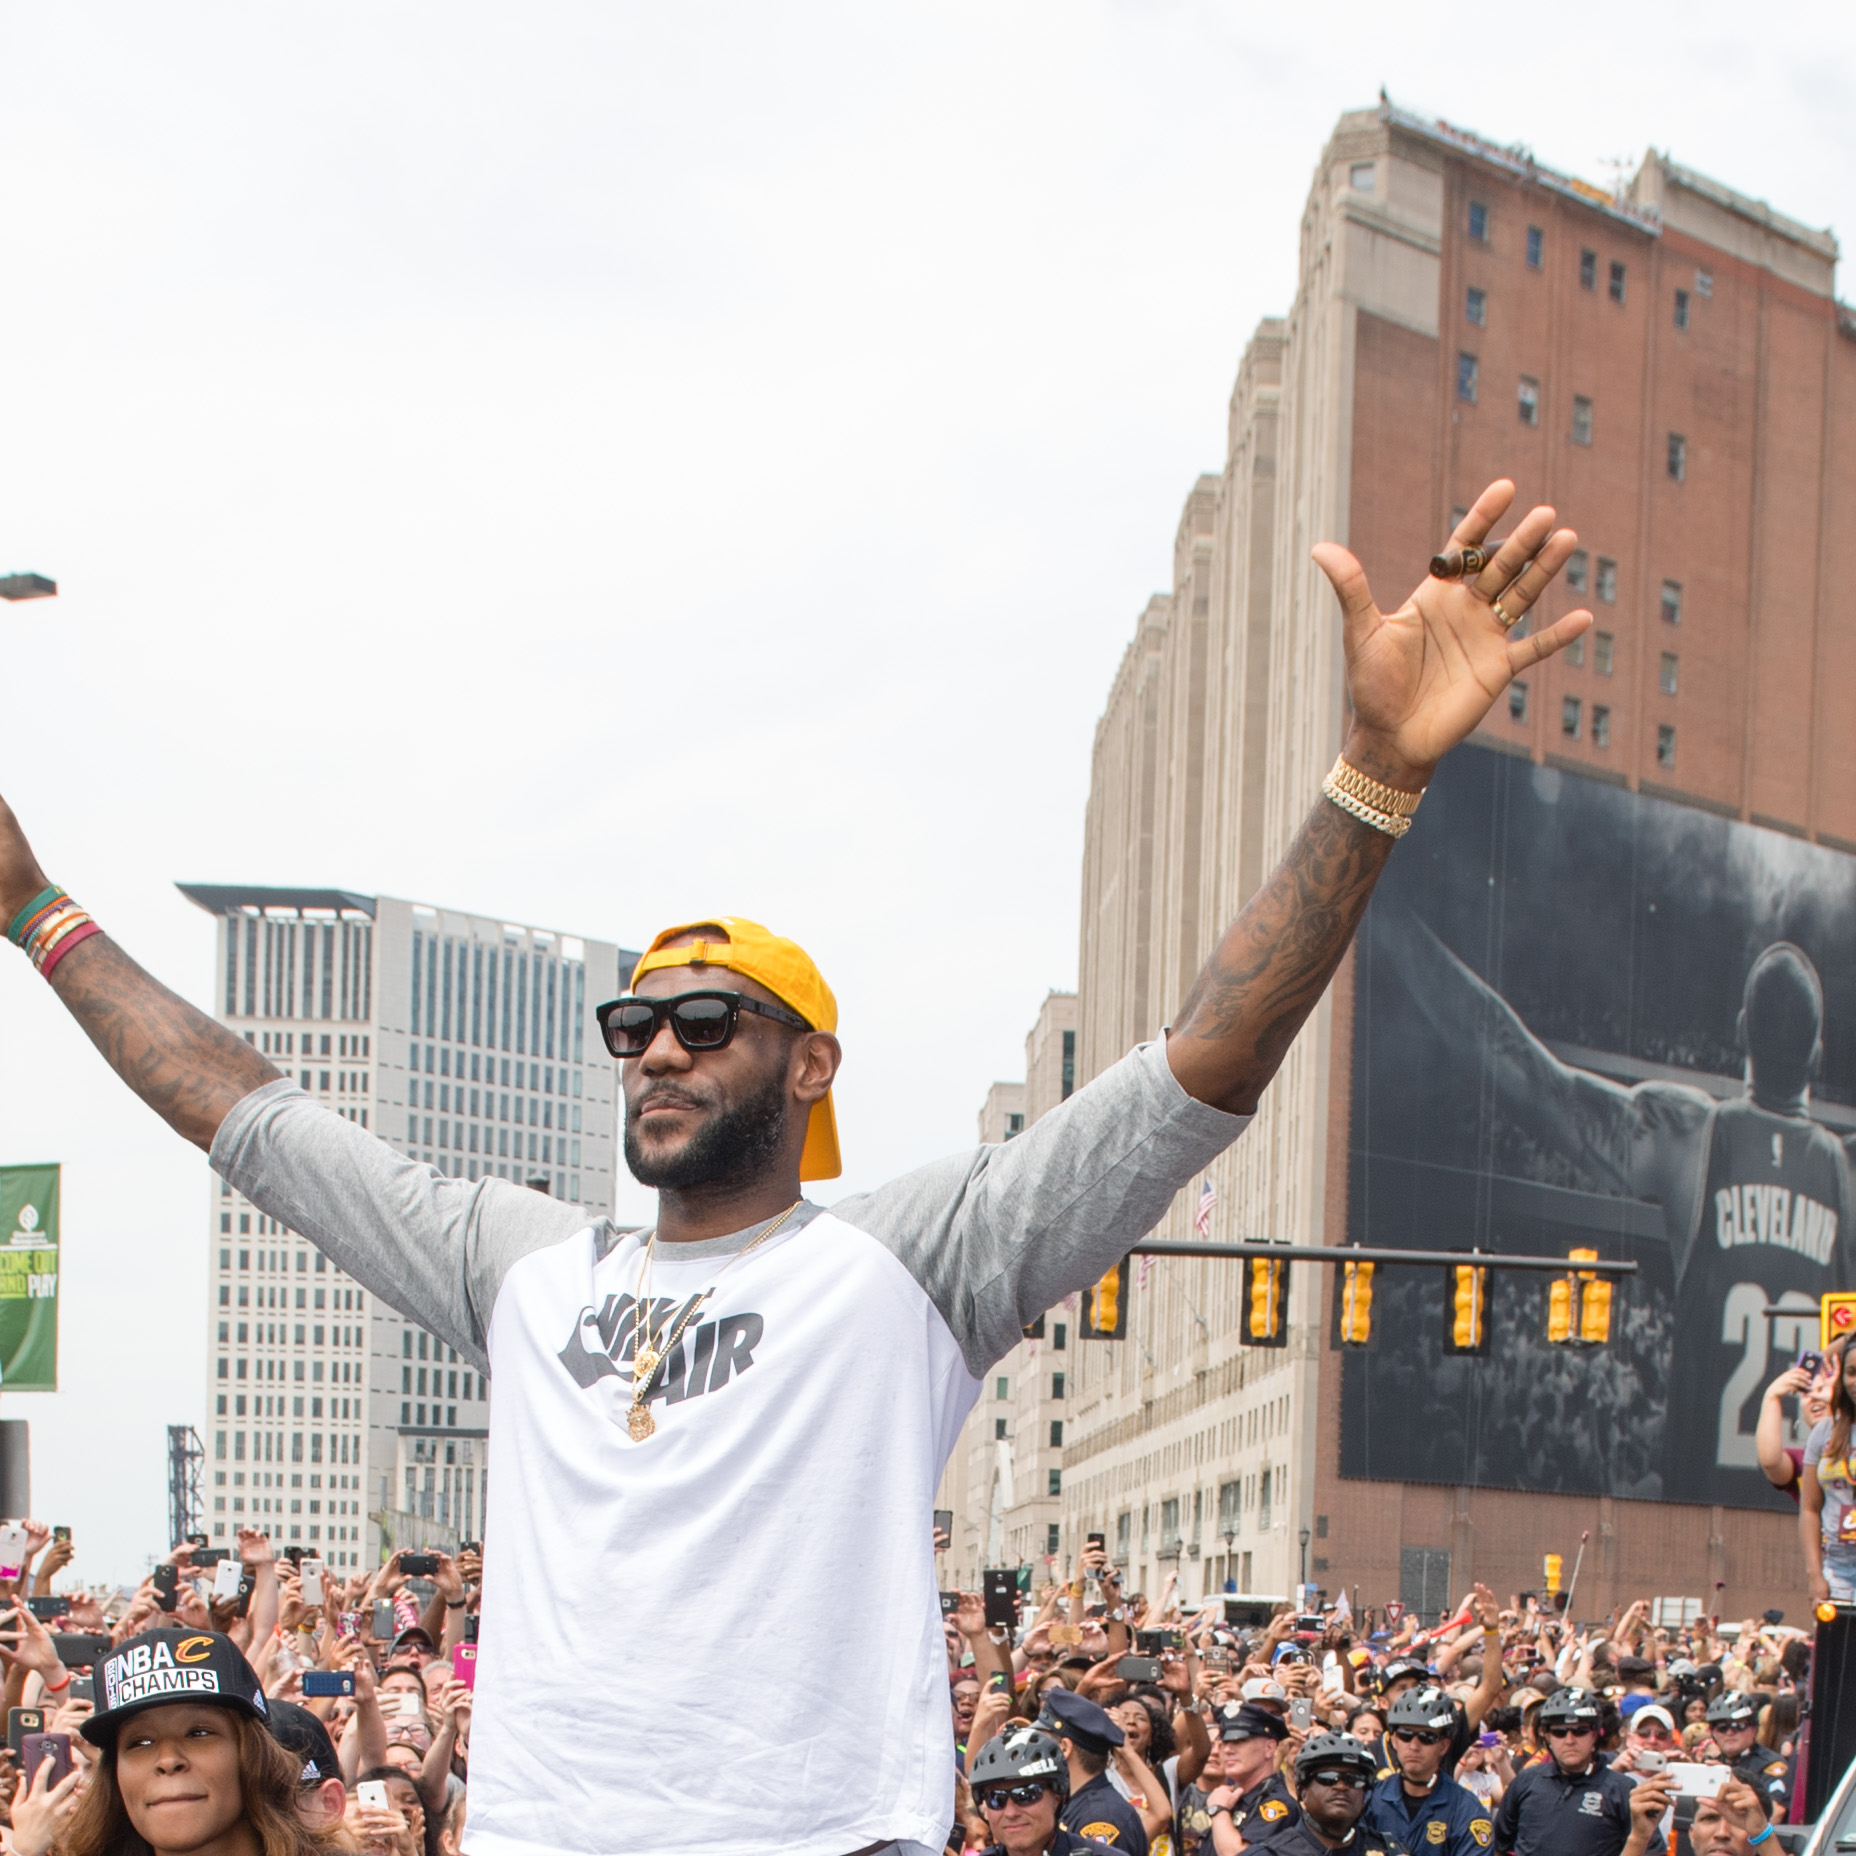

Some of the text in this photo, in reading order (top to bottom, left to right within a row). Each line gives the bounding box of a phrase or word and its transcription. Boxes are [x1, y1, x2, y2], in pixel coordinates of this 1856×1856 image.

[1716, 1185, 1838, 1266] CLEVELAND
[33, 1250, 58, 1275] OUT
[28, 1274, 57, 1299] PLAY
[594, 1287, 716, 1363] NIKE
[643, 1312, 764, 1406] AIR
[117, 1641, 175, 1682] NBA
[120, 1670, 217, 1703] CHAMPS
[1018, 1757, 1059, 1777] BELL
